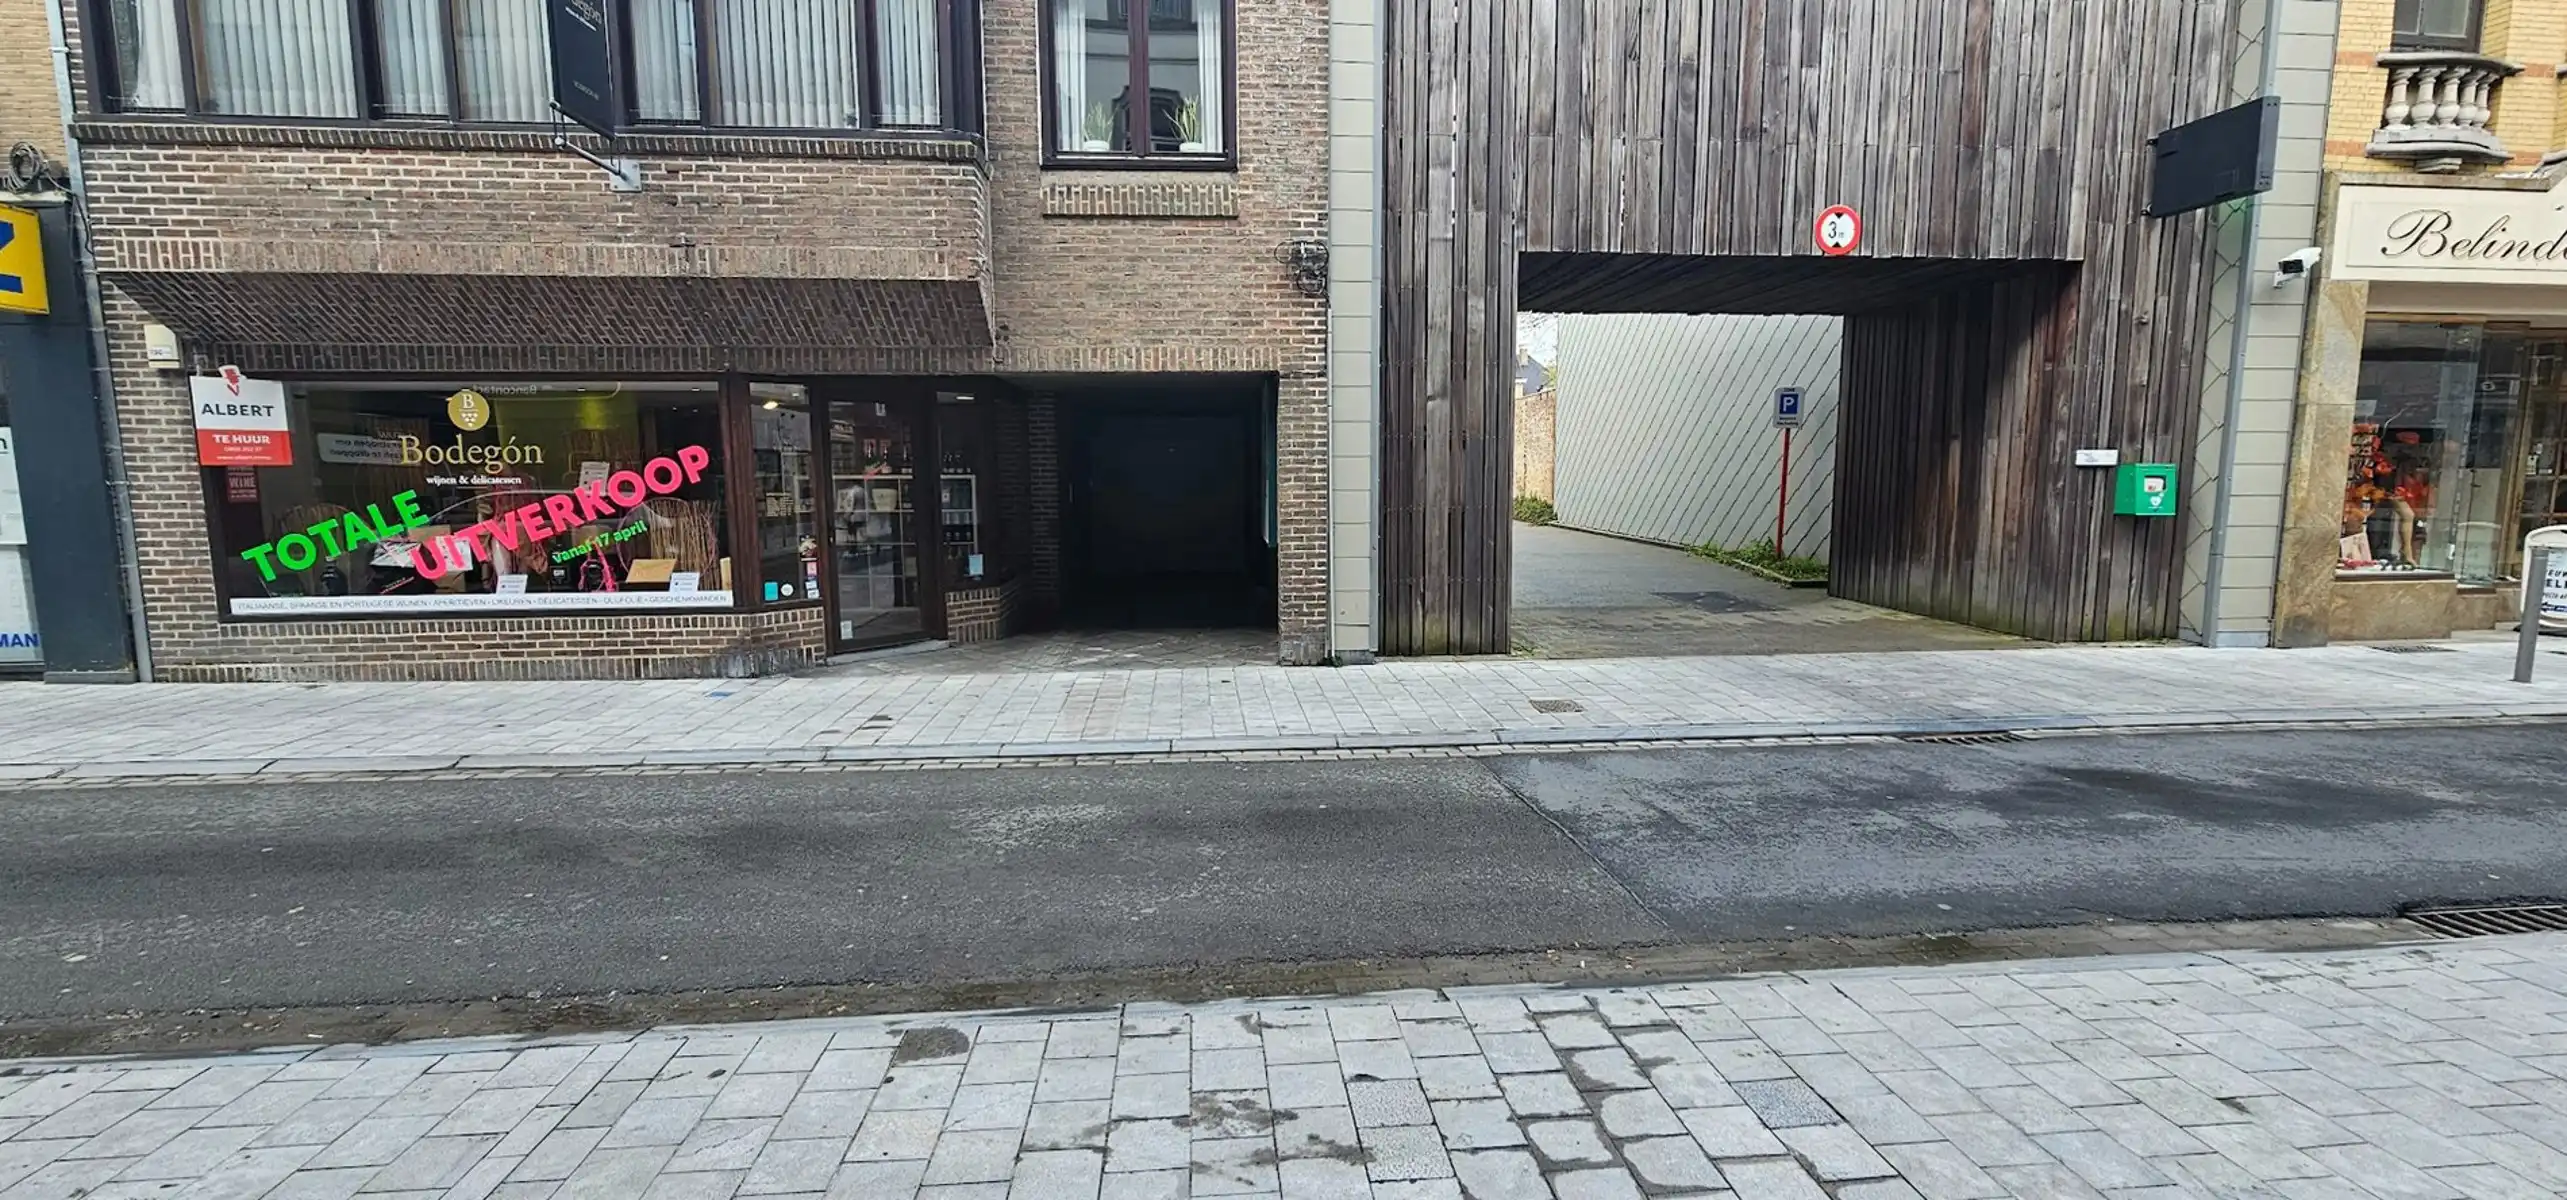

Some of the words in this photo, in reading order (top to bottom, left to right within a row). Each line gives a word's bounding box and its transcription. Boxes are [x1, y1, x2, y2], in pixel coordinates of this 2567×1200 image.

[1828, 220, 1837, 239] 3
[463, 393, 475, 409] B
[1783, 396, 1795, 412] P
[201, 403, 276, 417] ALBERT
[212, 434, 230, 444] TE
[232, 434, 271, 445] HUUR
[399, 433, 545, 475] Bodegón
[425, 475, 457, 487] wijnen
[458, 475, 469, 485] &
[470, 475, 522, 485] delicatessen
[410, 445, 709, 580] UITVERKOOP
[241, 489, 430, 582] TOTALE
[552, 537, 593, 564] vanaf
[595, 531, 610, 549] 17
[613, 519, 648, 543] april
